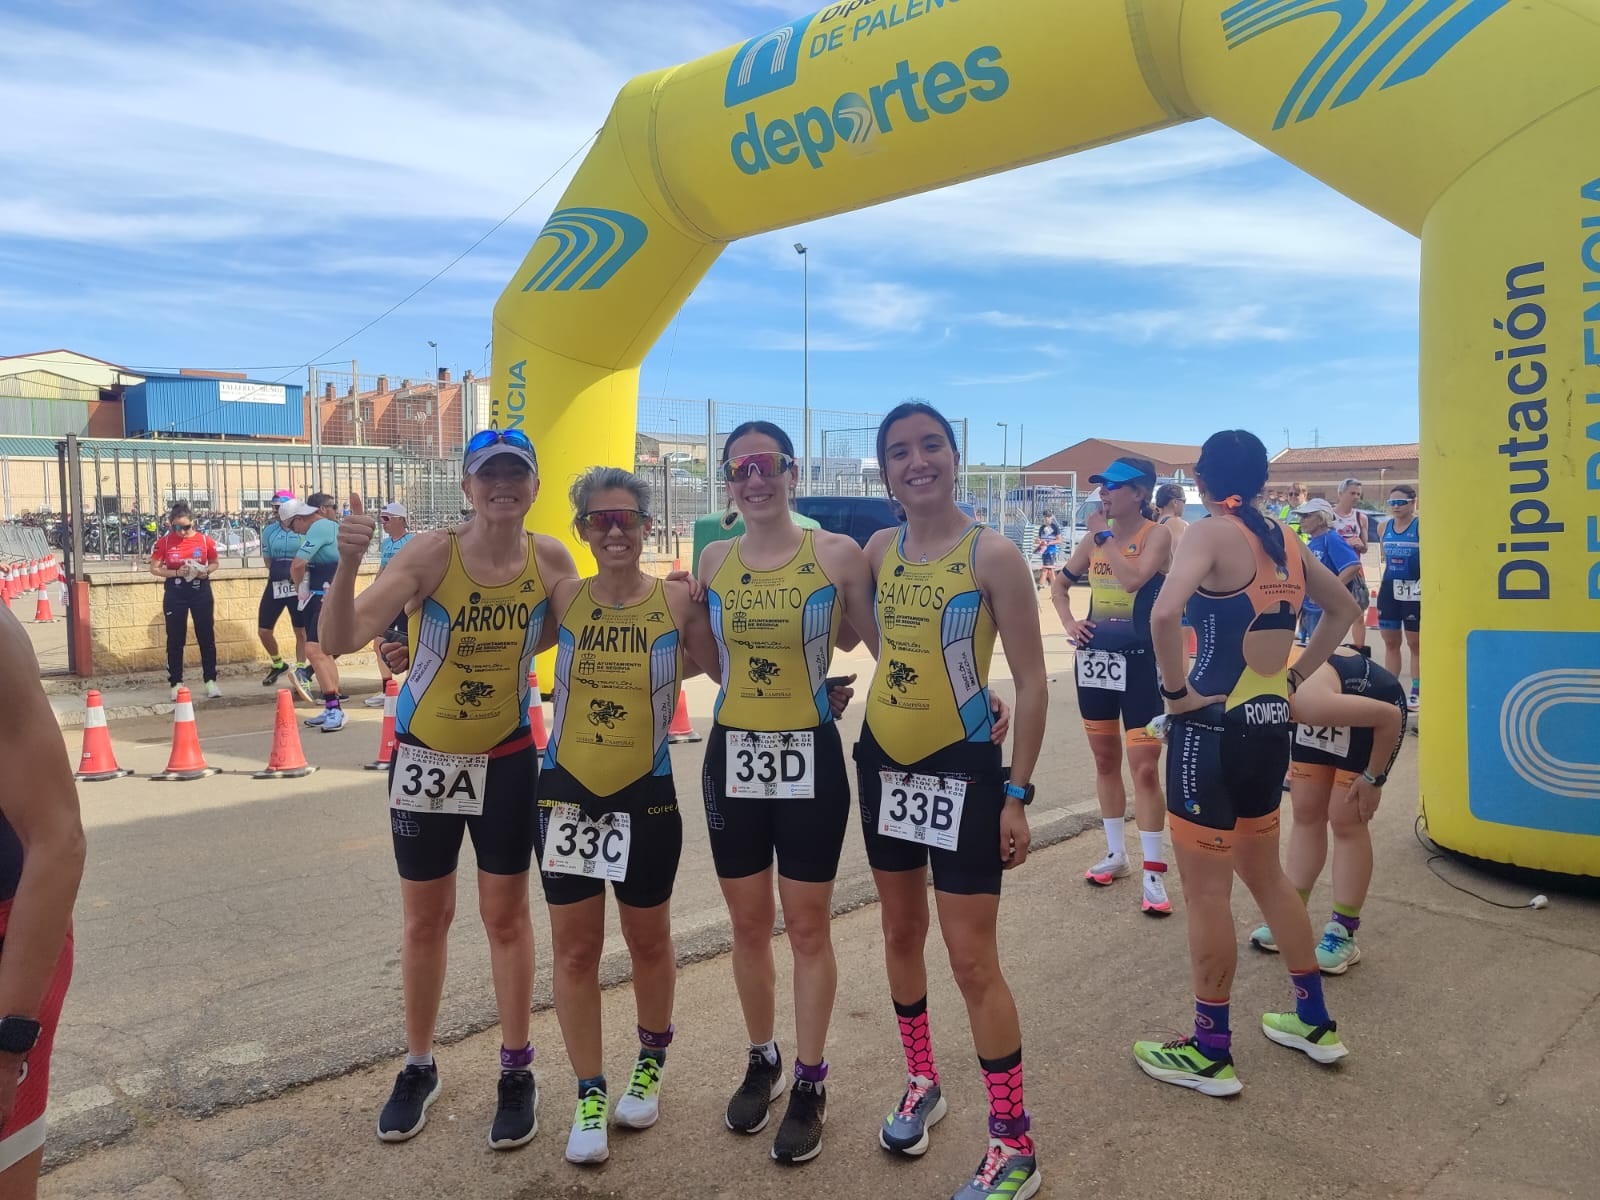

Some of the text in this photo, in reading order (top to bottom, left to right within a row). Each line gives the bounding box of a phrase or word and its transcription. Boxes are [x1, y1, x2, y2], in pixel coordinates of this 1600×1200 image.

[810, 24, 846, 58] DE
[731, 46, 1010, 175] deportes
[1494, 261, 1564, 599] Diputación
[724, 587, 802, 610] GIGANTO
[878, 582, 945, 610] SANTOS
[450, 602, 529, 632] ARROYO
[578, 623, 648, 653] MARTÍN
[1083, 660, 1122, 680] 32C
[1244, 702, 1290, 725] ROMERO
[736, 750, 806, 783] 33D
[1191, 735, 1201, 793] SALMANTINA
[402, 764, 477, 800] 33A
[889, 788, 954, 831] 33B
[555, 822, 624, 863] 33C
